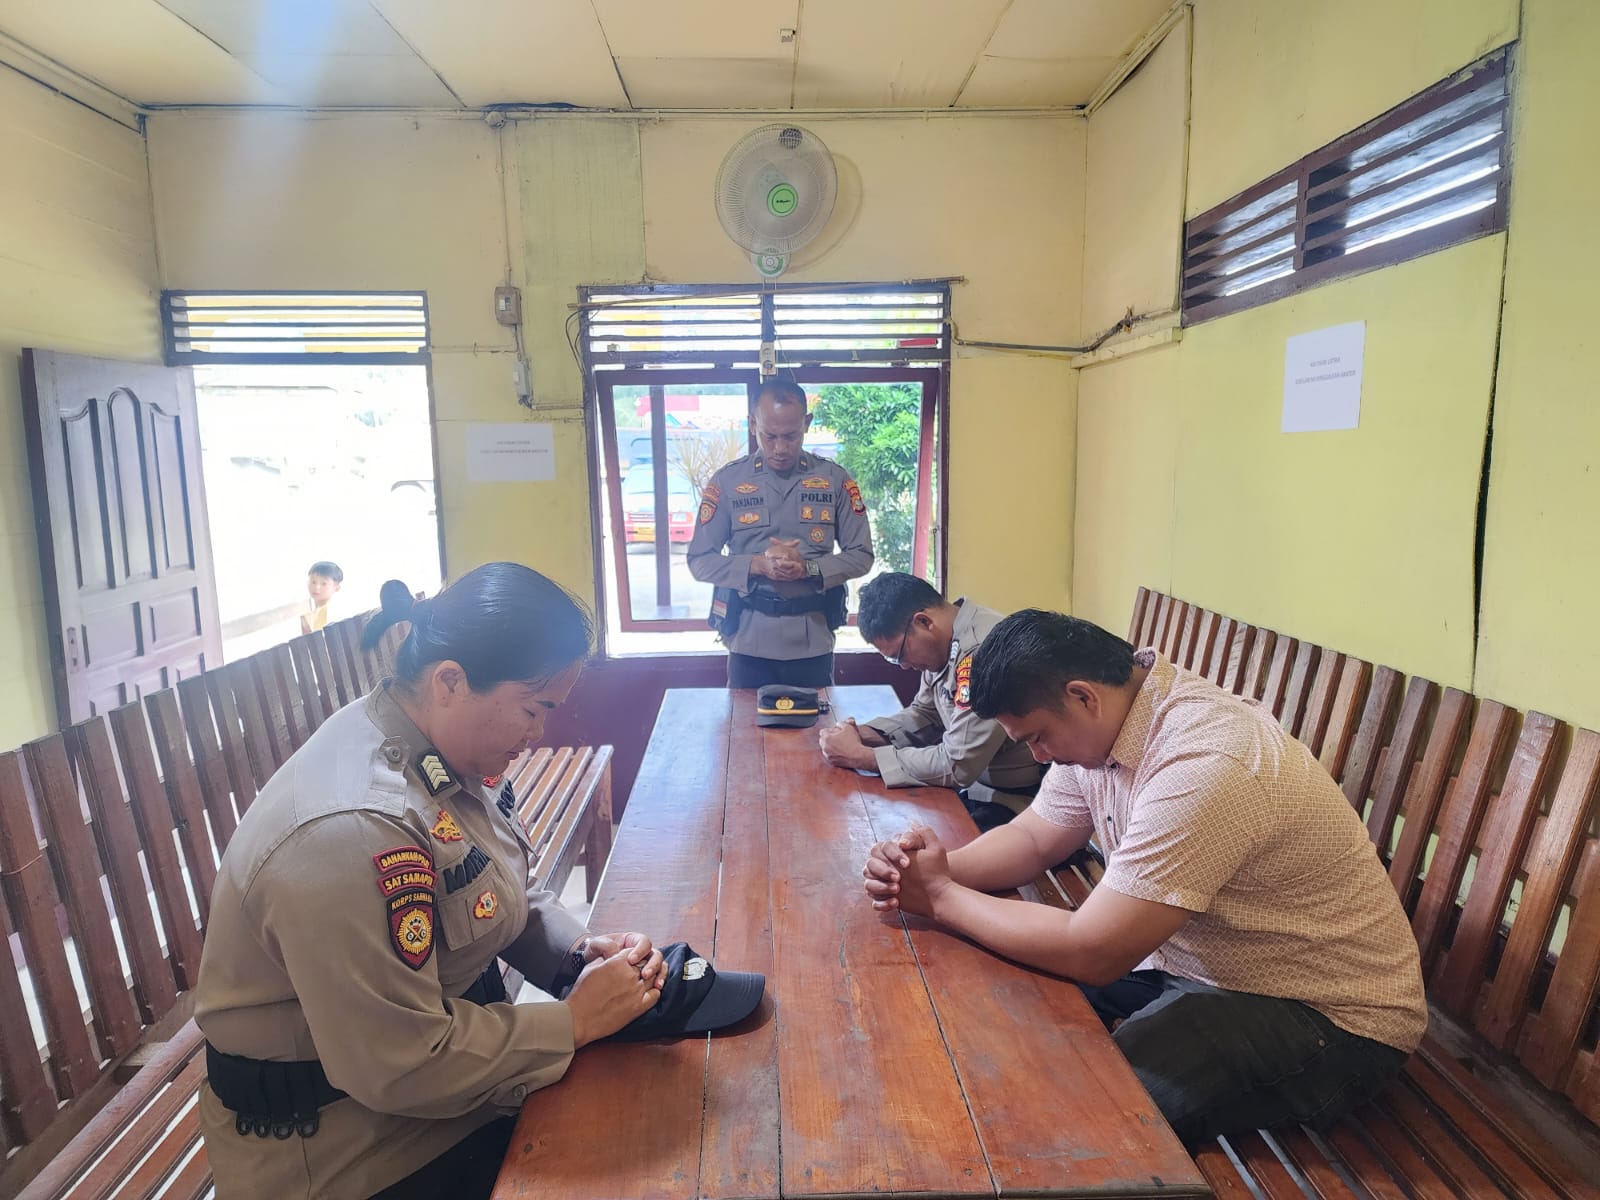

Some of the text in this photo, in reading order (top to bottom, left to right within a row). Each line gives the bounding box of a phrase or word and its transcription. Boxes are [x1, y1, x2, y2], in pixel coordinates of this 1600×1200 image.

[732, 496, 764, 509] PANJAITAN
[801, 493, 832, 503] POLRI
[385, 875, 402, 890] SAT
[391, 894, 412, 911] KORPS
